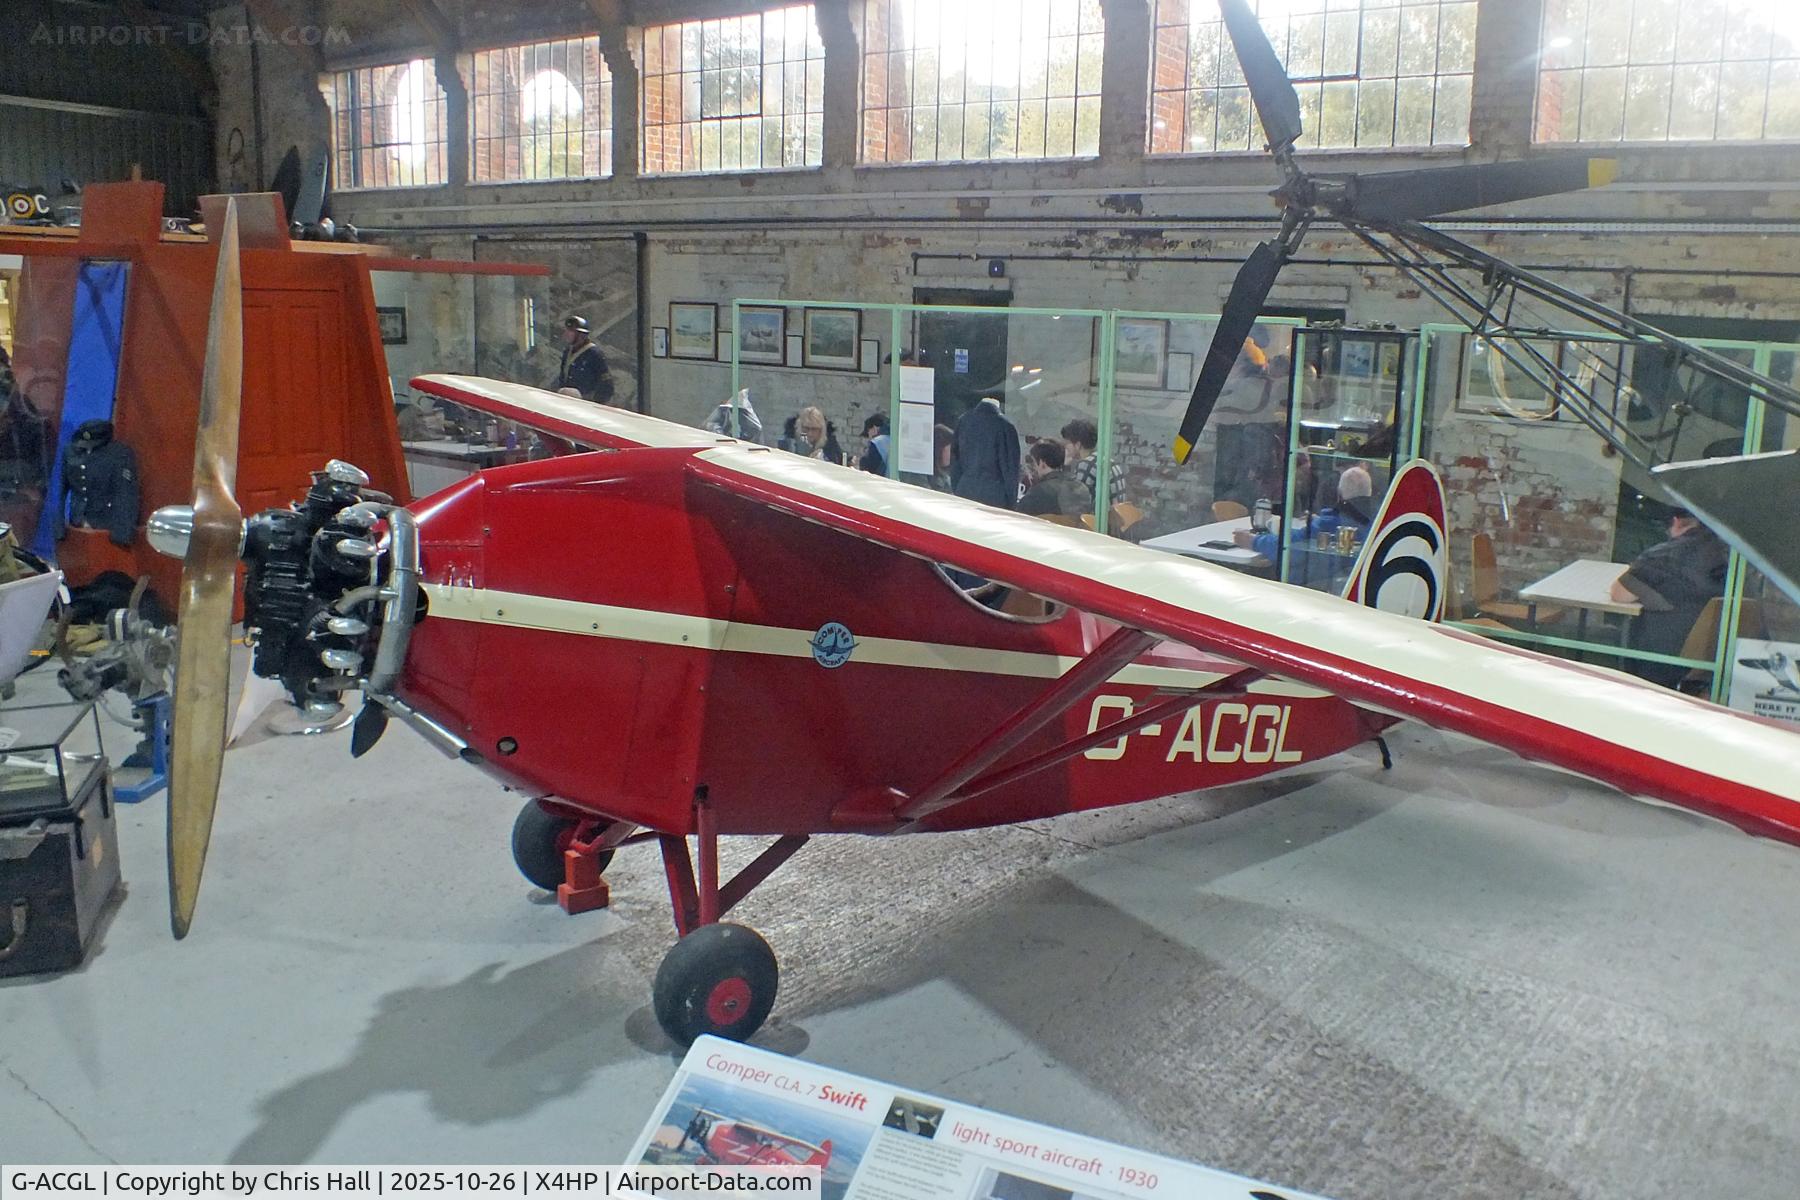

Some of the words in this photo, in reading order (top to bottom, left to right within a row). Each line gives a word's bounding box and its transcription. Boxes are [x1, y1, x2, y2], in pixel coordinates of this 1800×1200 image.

[705, 1053, 773, 1084] Comper
[806, 1083, 816, 1096] 7
[818, 1084, 868, 1112] Swift
[952, 1121, 991, 1147] light
[994, 1135, 1039, 1157] sport
[1041, 1145, 1103, 1176] aircraft
[1118, 1166, 1158, 1190] 1930
